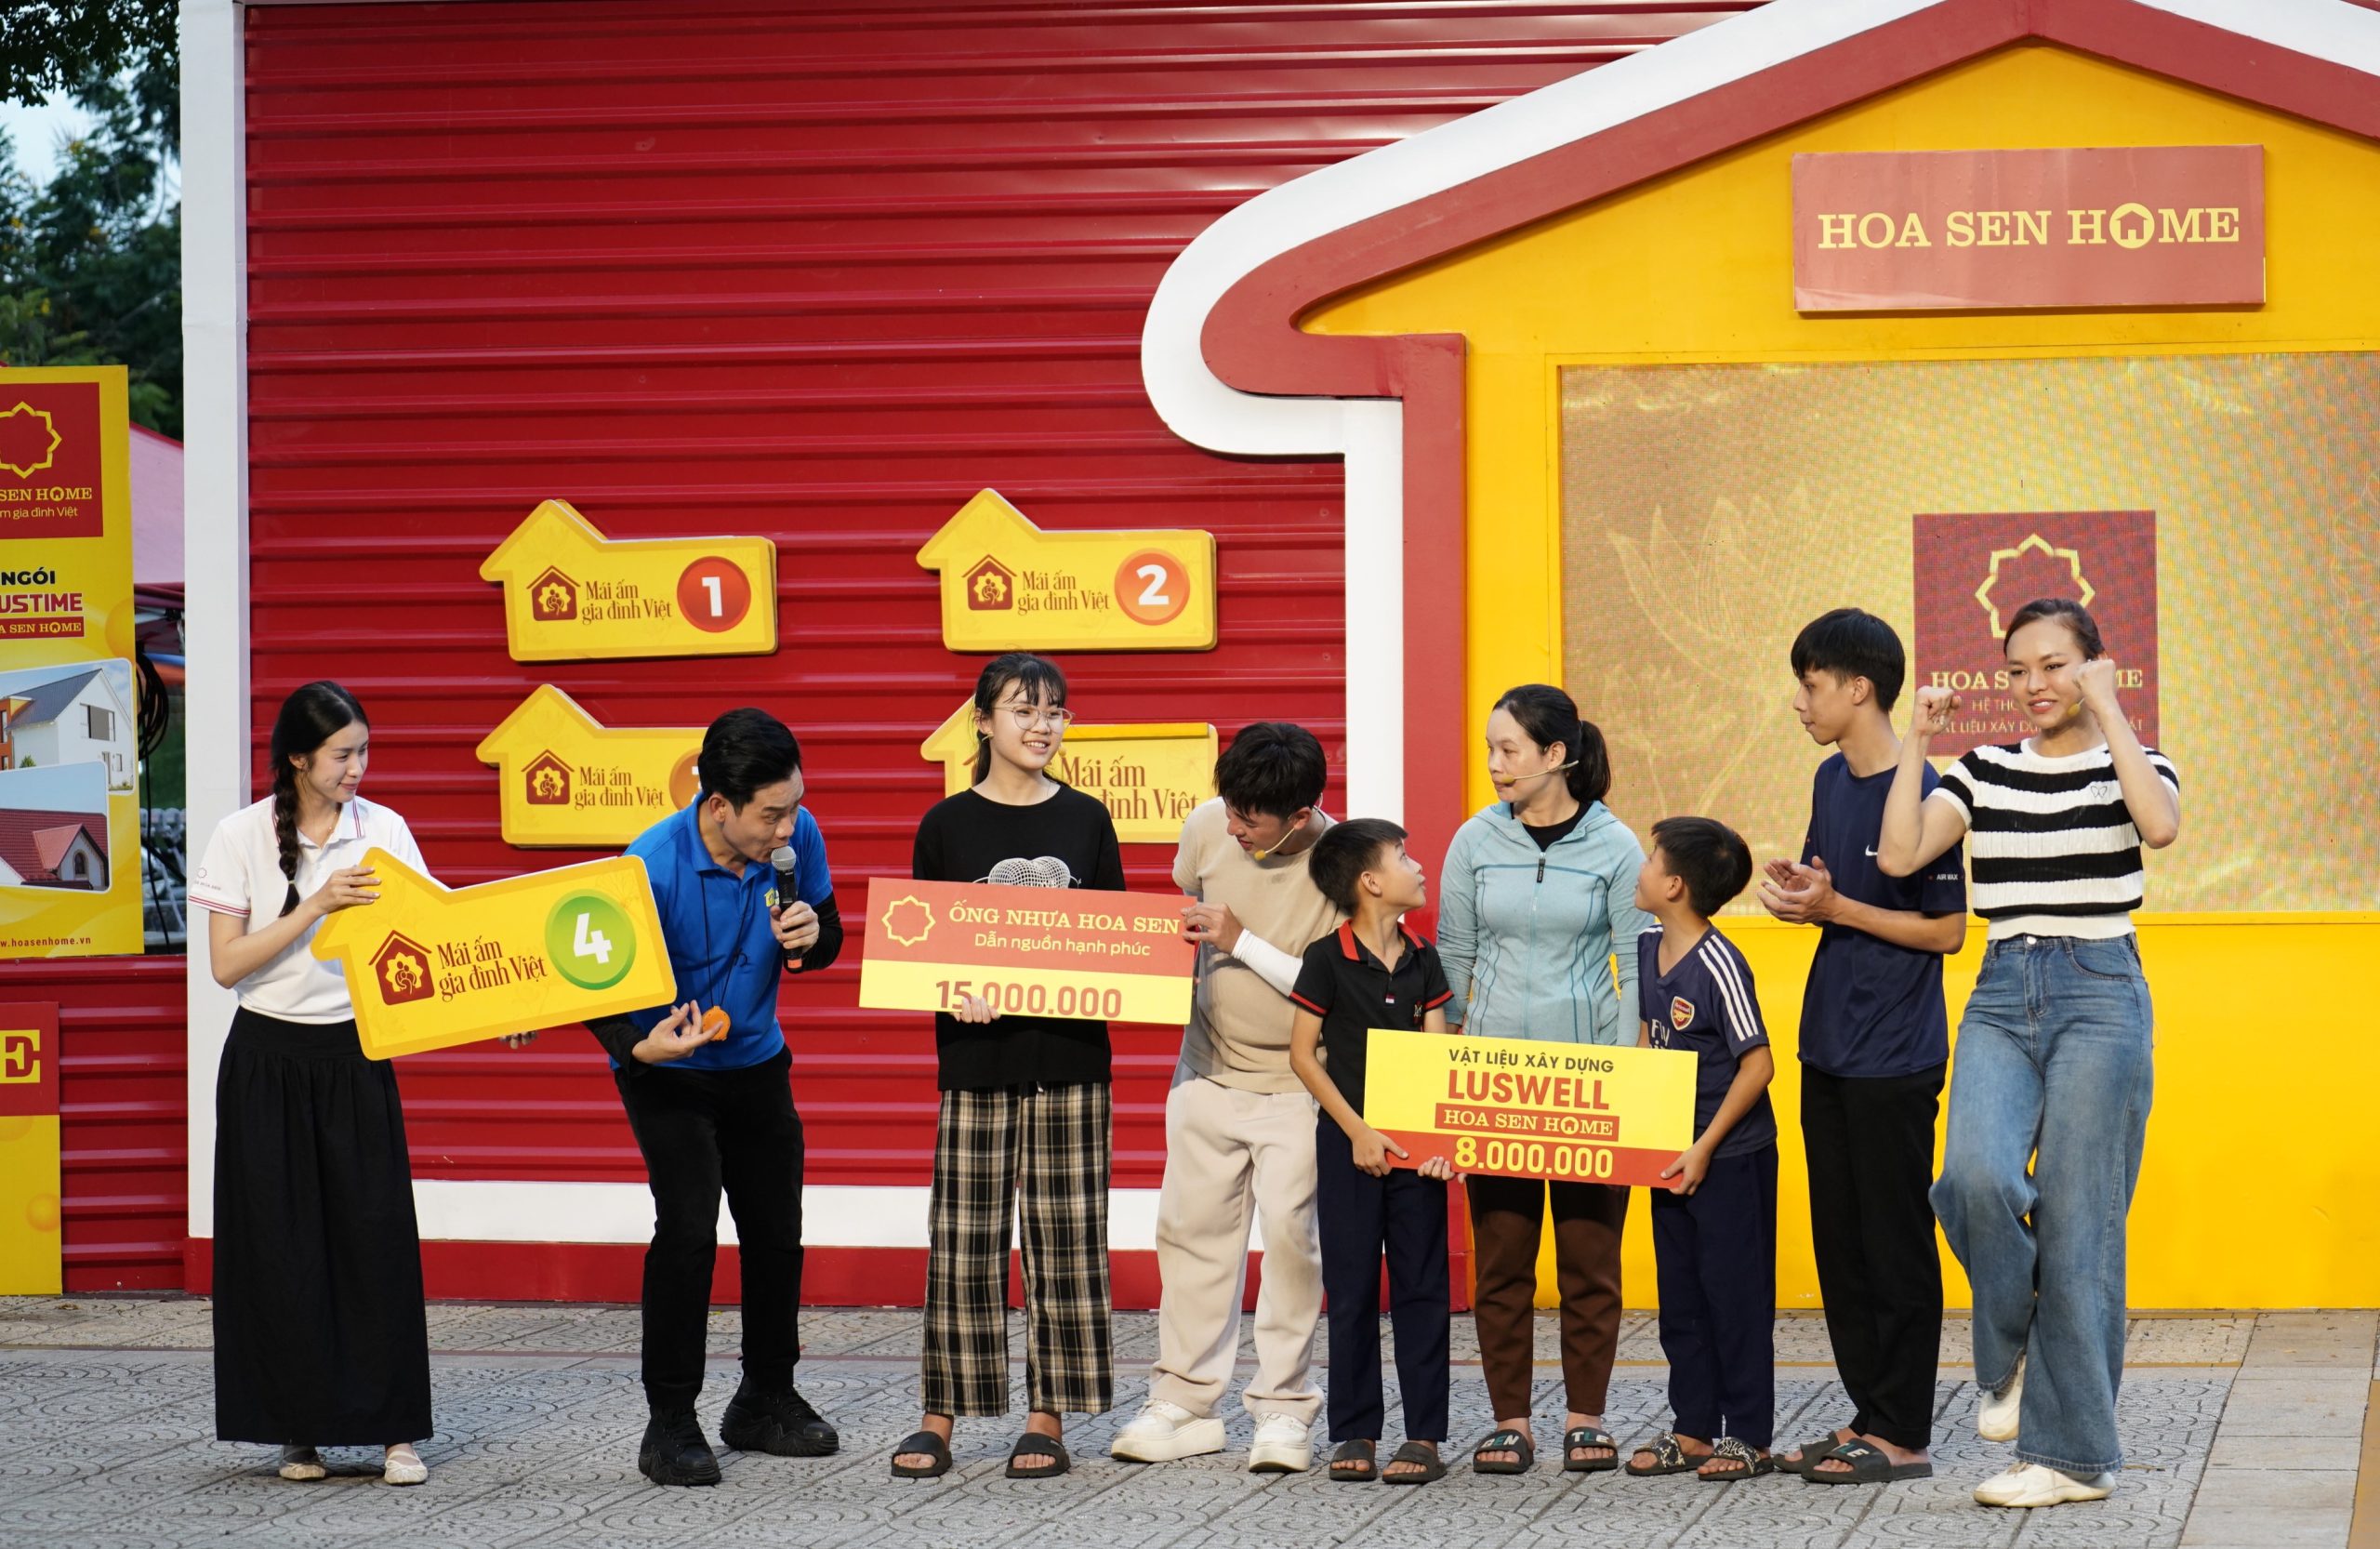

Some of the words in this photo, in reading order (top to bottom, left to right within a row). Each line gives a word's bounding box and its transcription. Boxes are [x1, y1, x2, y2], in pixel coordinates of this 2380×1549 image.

[1818, 212, 1931, 249] HOA
[1946, 209, 2052, 247] SEN
[2067, 202, 2240, 249] HOME
[0, 489, 33, 501] SEN
[35, 486, 93, 501] HOME
[13, 507, 29, 520] gia
[32, 507, 55, 518] đình
[57, 506, 78, 519] Việt
[1, 566, 56, 586] NGÓI
[1023, 571, 1048, 590] Mái
[1052, 569, 1077, 589] ấm
[1136, 563, 1170, 606] 2
[586, 580, 612, 601] Mái
[615, 579, 639, 600] ấm
[701, 576, 723, 617] 1
[1017, 593, 1039, 616] gia
[1044, 590, 1078, 611] đình
[1080, 589, 1110, 613] Việt
[582, 602, 603, 626] gia
[607, 600, 641, 620] đình
[643, 599, 672, 621] Việt
[9, 624, 35, 633] SEN
[39, 622, 82, 633] HOME
[1931, 670, 1990, 691] HOA
[579, 765, 605, 787] Mái
[609, 765, 632, 787] ấm
[1061, 756, 1102, 788] Mái
[1109, 755, 1145, 788] ấm
[575, 788, 596, 811] gia
[600, 787, 633, 806] đình
[636, 787, 665, 809] Việt
[948, 899, 1000, 924] ỐNG
[1005, 909, 1072, 933] NHỰA
[1078, 914, 1128, 933] HOA
[1133, 917, 1181, 934] SEN
[573, 912, 614, 965] 4
[974, 931, 1005, 947] Dẫn
[1011, 933, 1063, 954] nguồn
[1065, 939, 1106, 956] hạnh
[1110, 939, 1151, 957] phúc
[436, 941, 472, 970] Mái
[473, 935, 503, 962] ấm
[439, 973, 466, 1002] gia
[469, 960, 510, 990] đình
[509, 955, 549, 983] Việt
[1651, 1019, 1670, 1047] Fly
[1448, 1047, 1481, 1067] VẬT
[1486, 1050, 1519, 1069] LIỆU
[1525, 1052, 1559, 1069] XÂY
[1566, 1056, 1615, 1075] DỰNG
[1448, 1069, 1610, 1111] LUSWELL
[1443, 1109, 1489, 1128] HOA
[1495, 1113, 1539, 1131] SEN
[1543, 1116, 1614, 1136] HOME
[1454, 1136, 1614, 1179] 8.000.000
